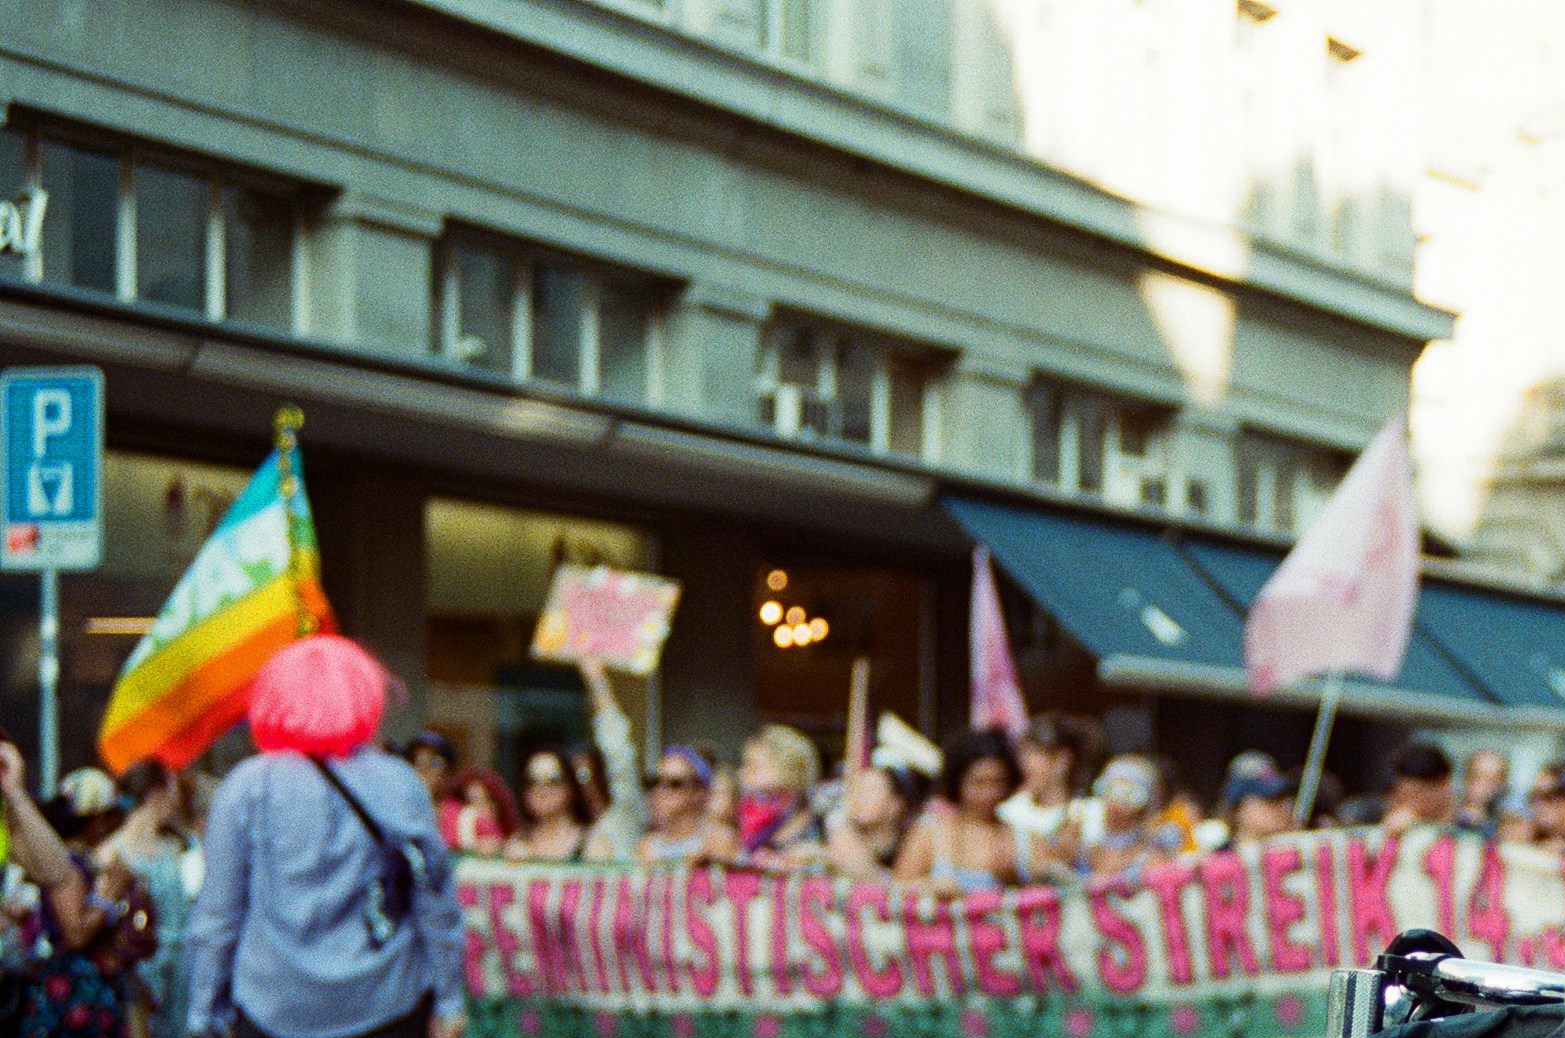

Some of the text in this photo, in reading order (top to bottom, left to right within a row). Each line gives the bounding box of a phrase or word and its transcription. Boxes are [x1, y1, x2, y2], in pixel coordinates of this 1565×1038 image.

[33, 388, 72, 459] P
[457, 866, 1079, 998] FEMINISTISCHER
[1090, 835, 1398, 993] STREIK
